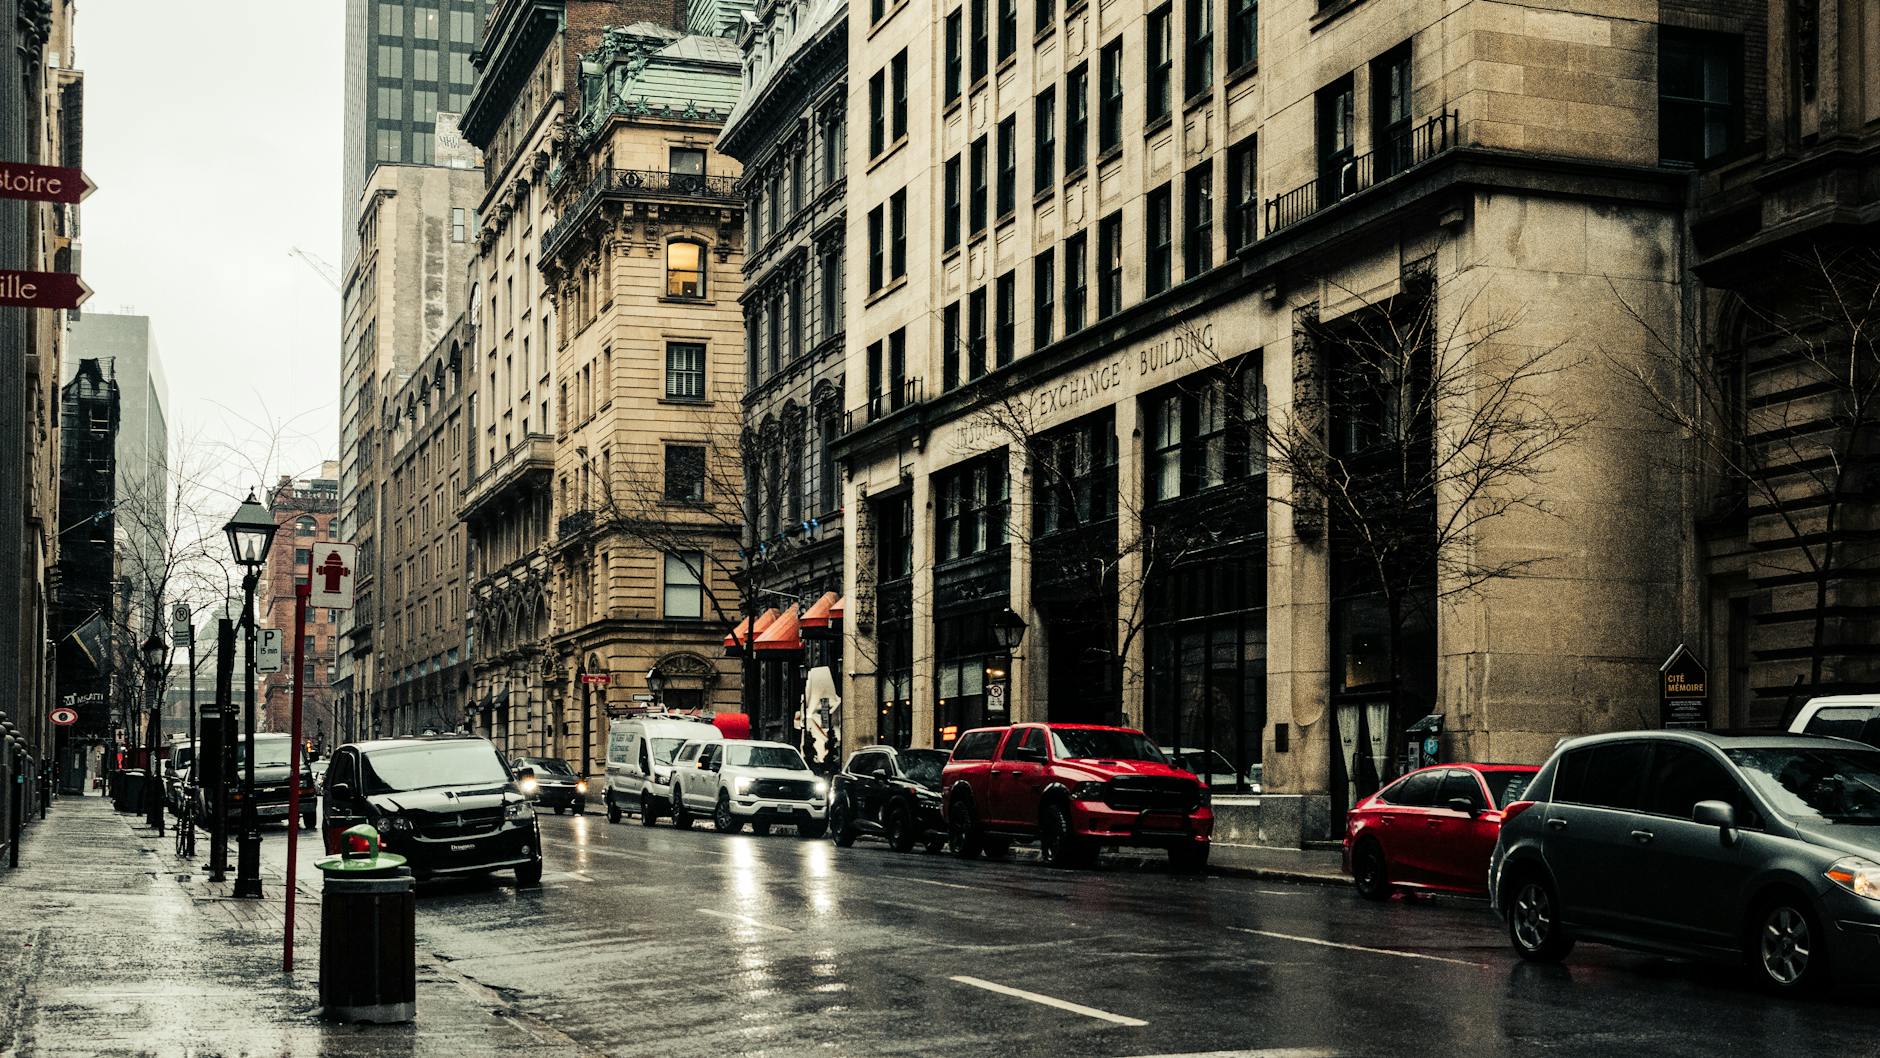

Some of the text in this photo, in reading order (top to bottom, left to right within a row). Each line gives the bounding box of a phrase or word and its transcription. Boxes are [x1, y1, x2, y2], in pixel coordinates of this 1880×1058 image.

[1040, 361, 1121, 416] EXCHANGE
[1139, 323, 1214, 377] BUILDING
[264, 630, 275, 647] P
[1667, 672, 1685, 683] CITÉ
[1667, 682, 1704, 692] MÉMOIRE
